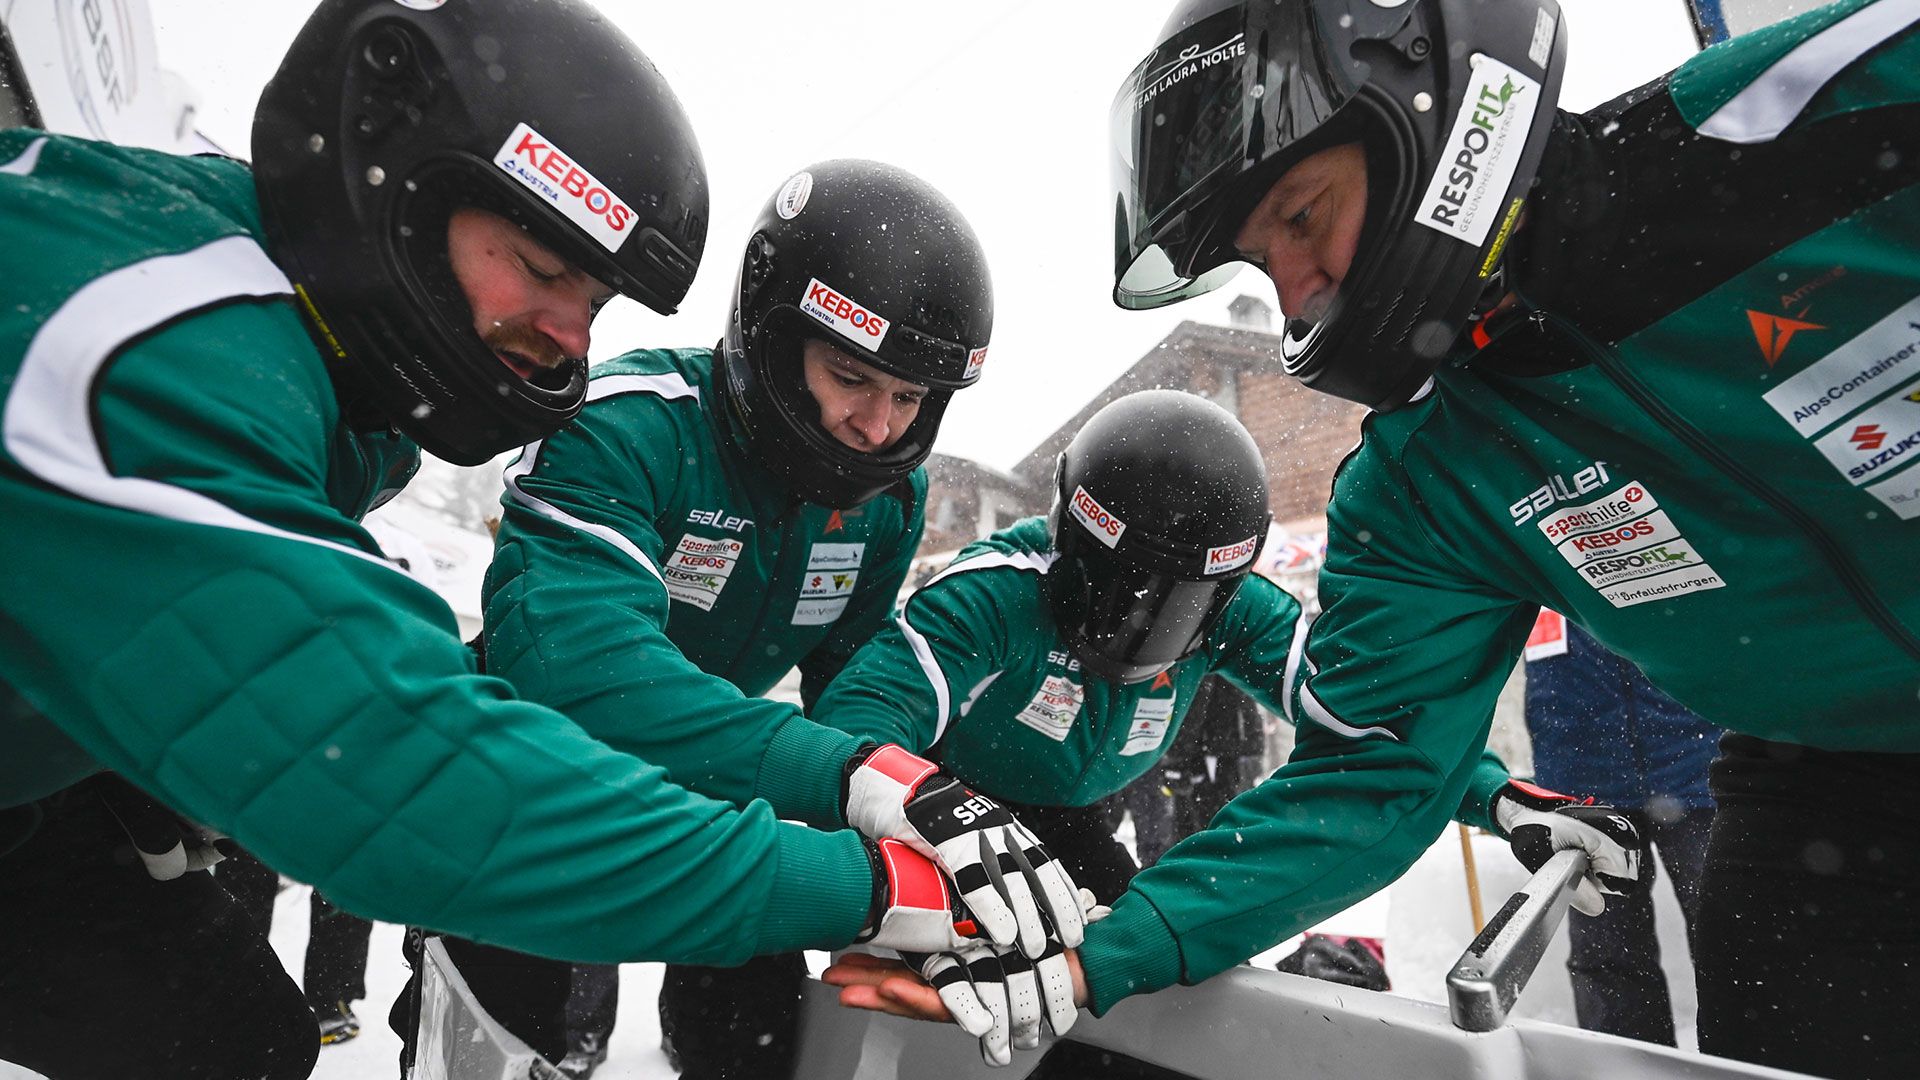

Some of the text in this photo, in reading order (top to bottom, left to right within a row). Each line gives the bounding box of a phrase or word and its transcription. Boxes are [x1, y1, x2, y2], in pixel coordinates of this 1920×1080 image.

[1134, 42, 1246, 112] TEAM LAURA NOLTE
[1431, 84, 1501, 227] RESPOFIT
[1459, 102, 1517, 233] GESUNDHEITSZENTRUM
[514, 132, 631, 231] KEBOS
[517, 168, 559, 201] AUSTRIA
[808, 283, 883, 337] KEBOS
[810, 307, 835, 325] AUSTRIA
[1793, 343, 1917, 423] AlpsContainer
[1848, 431, 1920, 479] SUZUK
[1075, 490, 1121, 536] KEBOS
[1509, 461, 1610, 527] saller
[1546, 500, 1632, 537] sporthilfe
[1572, 519, 1655, 552] KEBOS
[680, 555, 726, 569] KEBOS
[1211, 538, 1255, 564] KEBOS
[1584, 546, 1669, 579] RESPOFIT
[1596, 560, 1677, 585] GESUNDHEITSZENTRUM
